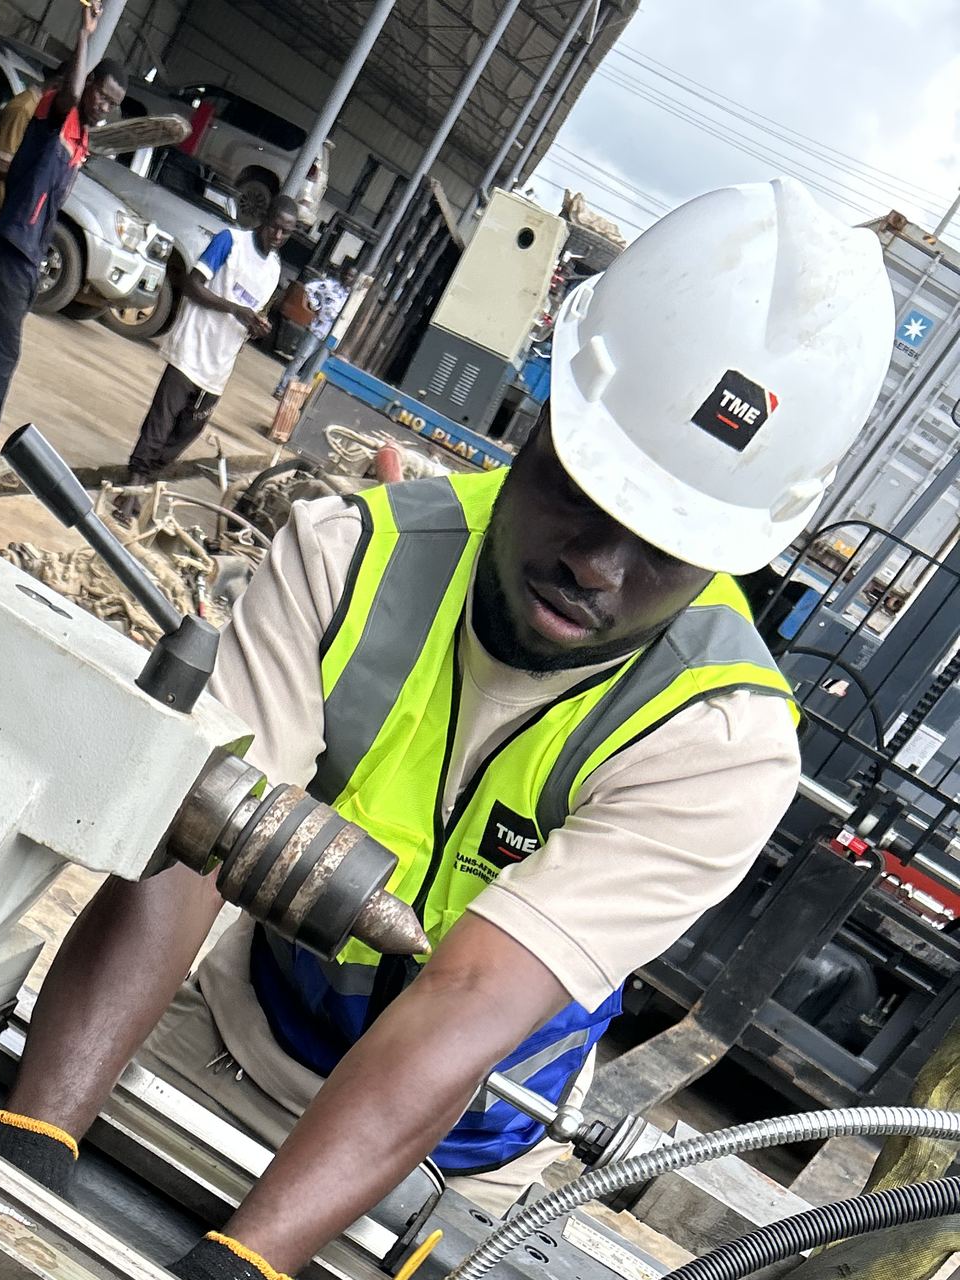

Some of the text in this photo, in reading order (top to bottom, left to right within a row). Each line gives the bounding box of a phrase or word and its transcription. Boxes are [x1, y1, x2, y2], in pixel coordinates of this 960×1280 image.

[720, 389, 761, 425] TME
[399, 409, 426, 432] NO
[431, 427, 479, 460] PLAY
[495, 822, 538, 853] TME
